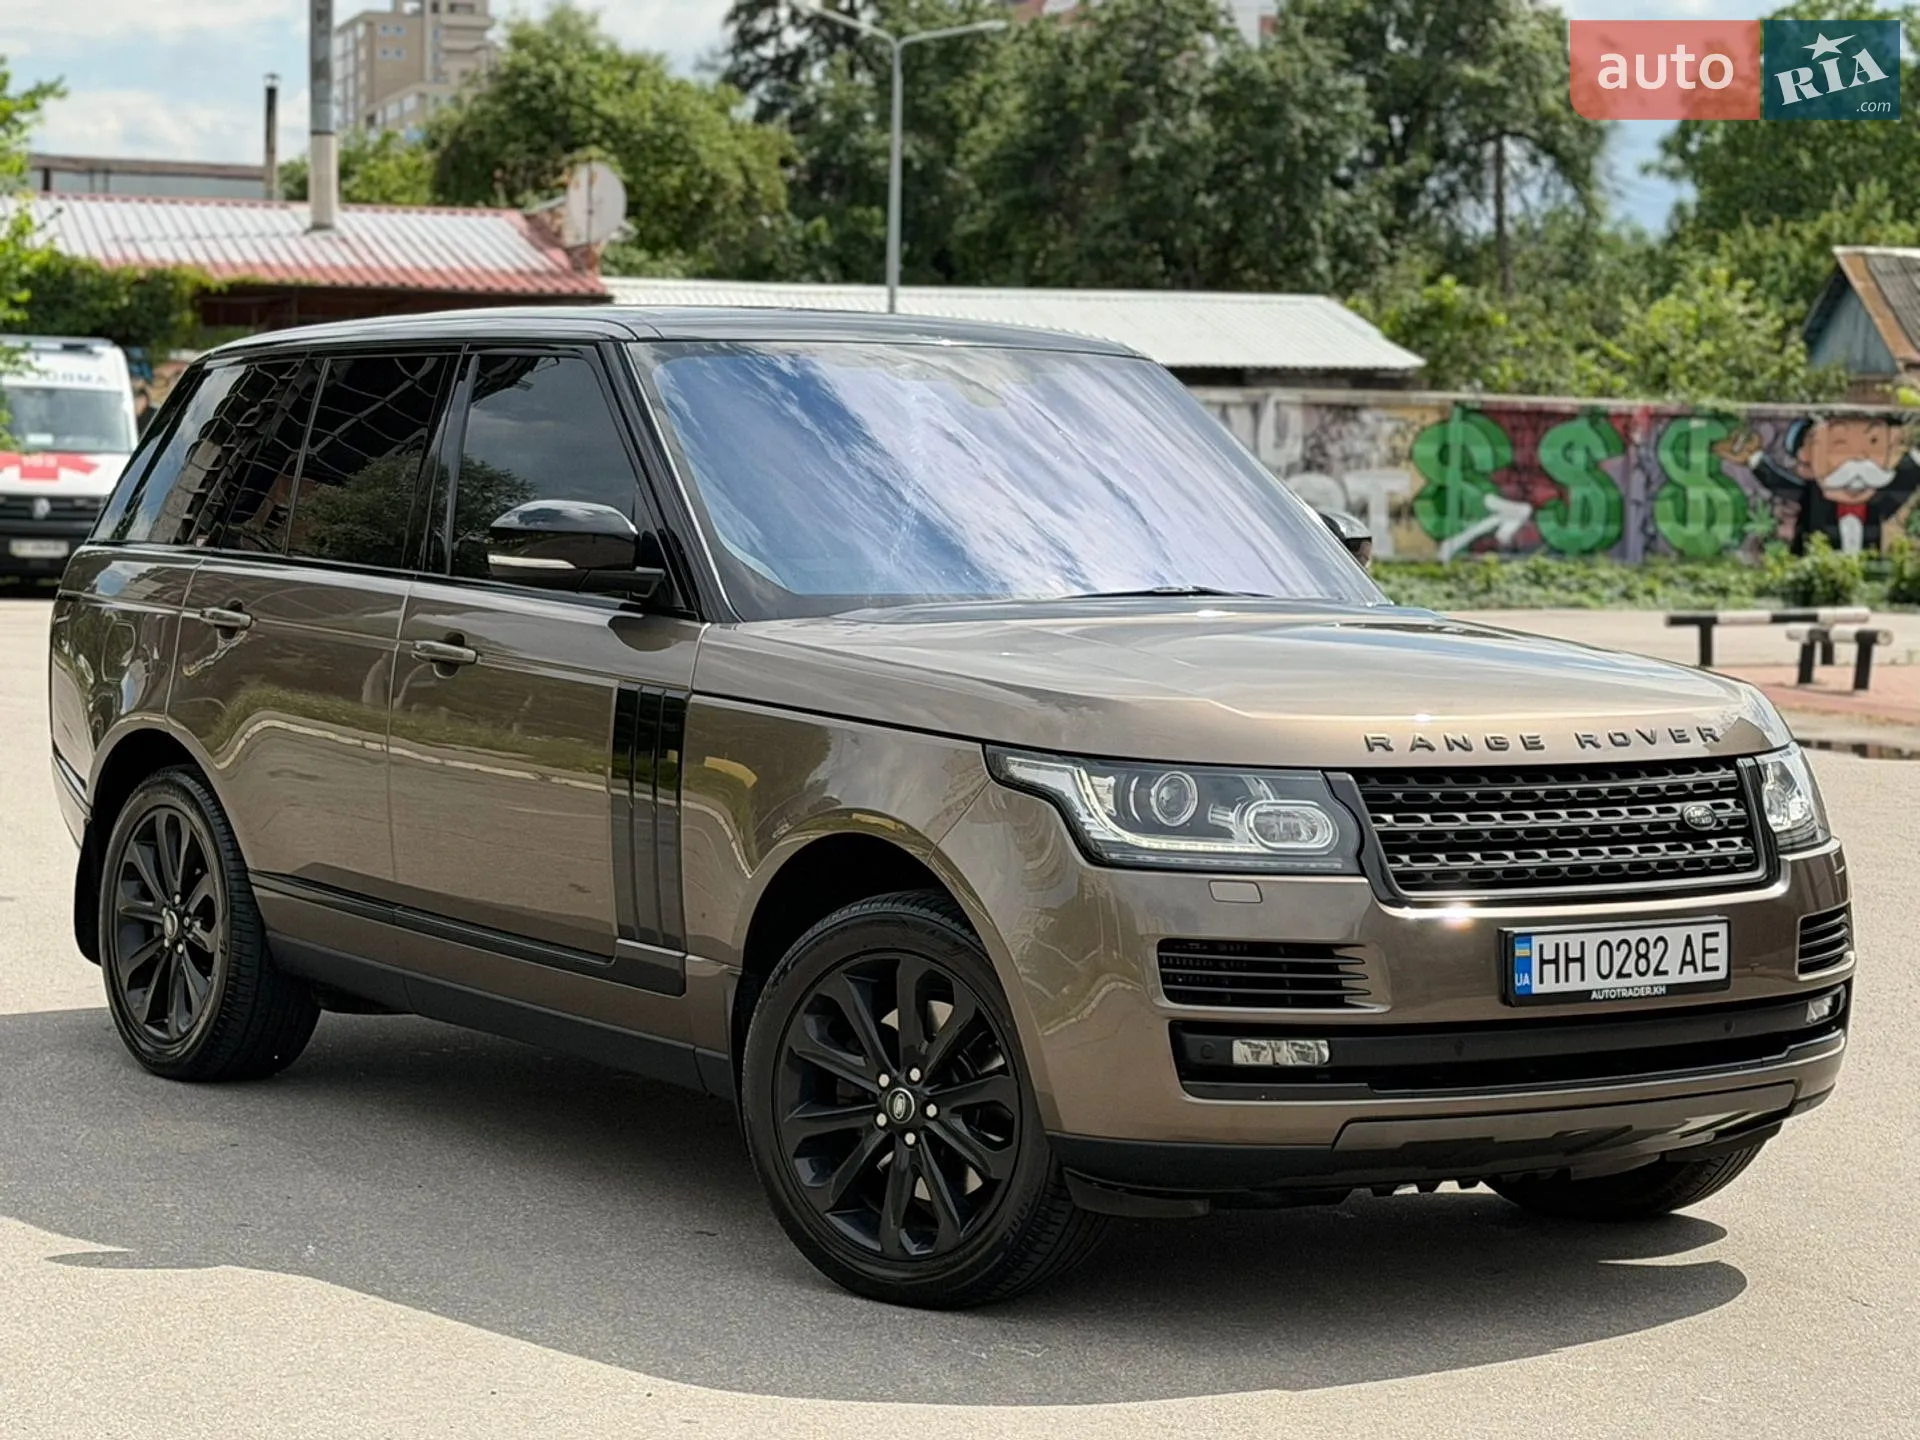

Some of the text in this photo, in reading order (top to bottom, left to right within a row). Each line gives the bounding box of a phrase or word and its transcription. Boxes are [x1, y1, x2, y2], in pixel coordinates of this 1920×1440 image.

[1365, 726, 1724, 753] RANGE ROVER
[1538, 931, 1720, 985] HH 0282 AE
[1515, 973, 1530, 986] UA
